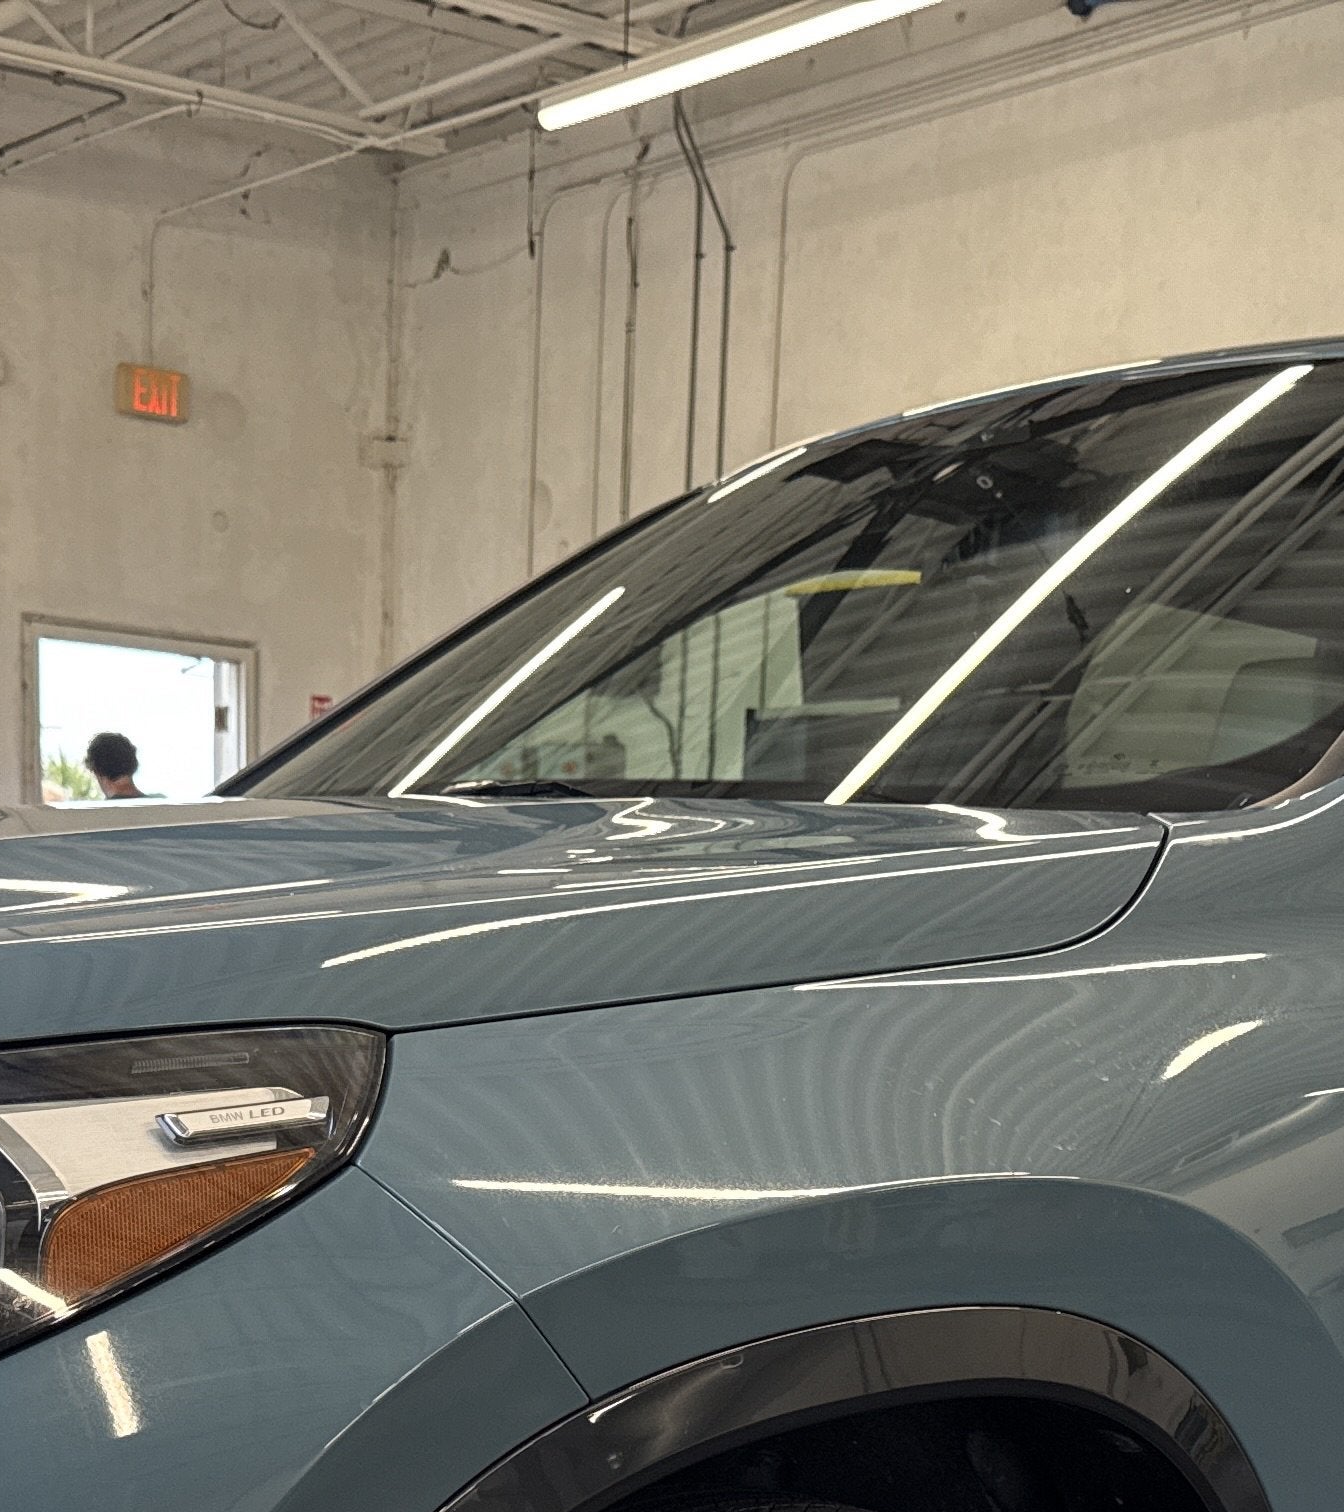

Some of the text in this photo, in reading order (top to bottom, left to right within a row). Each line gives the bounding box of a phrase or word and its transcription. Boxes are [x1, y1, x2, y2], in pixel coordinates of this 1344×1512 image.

[133, 368, 181, 417] EXIT
[209, 1106, 285, 1124] BMW LED
